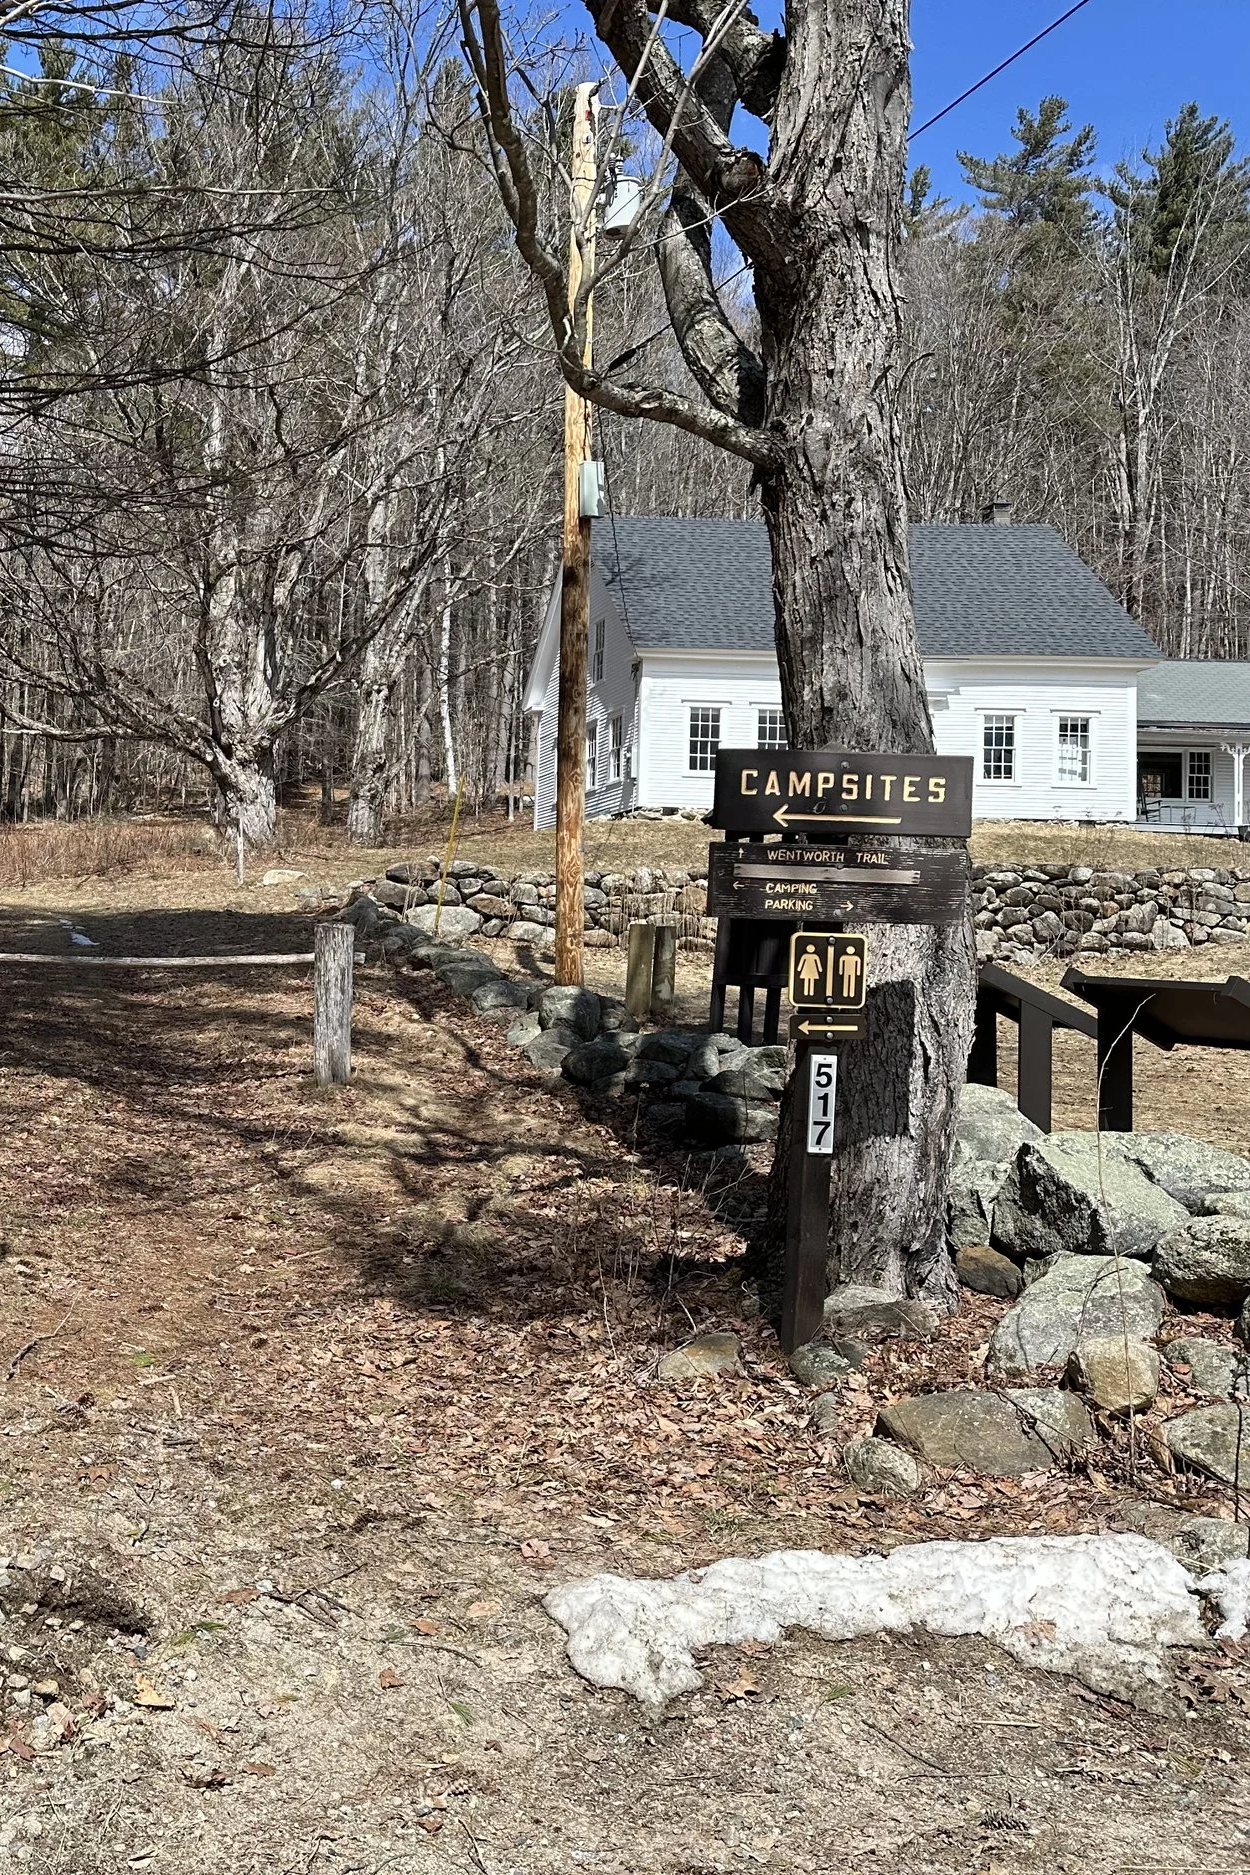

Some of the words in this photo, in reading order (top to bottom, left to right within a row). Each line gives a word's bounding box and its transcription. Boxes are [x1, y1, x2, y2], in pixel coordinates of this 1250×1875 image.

[740, 768, 946, 803] CAMPSITES
[767, 849, 845, 862] WENTWORTH
[856, 852, 888, 864] TRAIL
[765, 882, 818, 894] CAMPING
[764, 899, 813, 911] PARKING
[813, 1063, 832, 1145] 517
